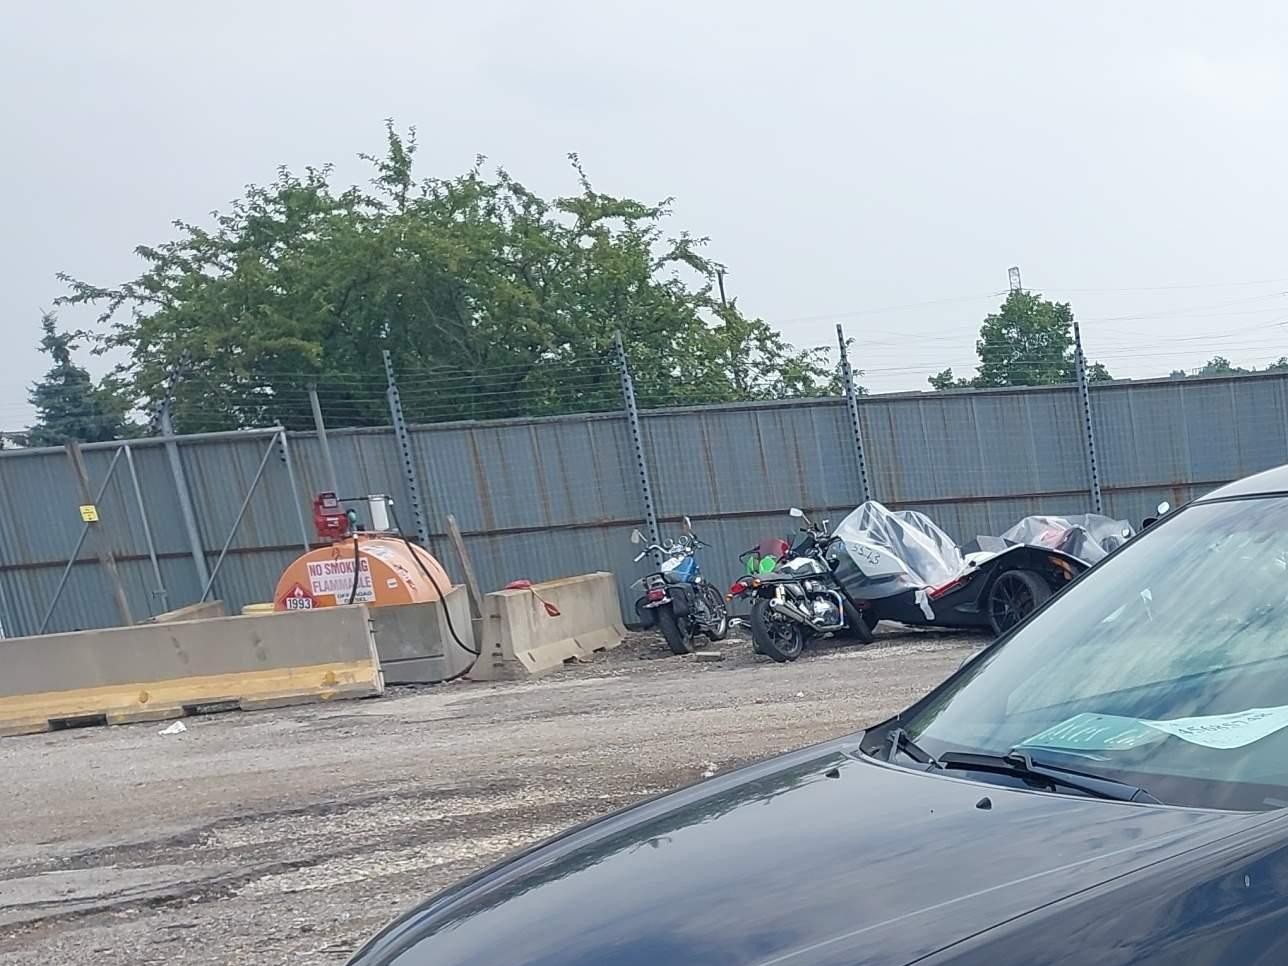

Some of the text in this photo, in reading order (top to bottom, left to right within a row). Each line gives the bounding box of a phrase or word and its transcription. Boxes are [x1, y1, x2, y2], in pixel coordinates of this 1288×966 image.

[309, 564, 323, 576] NO
[312, 576, 372, 593] FLAMMALE
[287, 599, 311, 609] 1993
